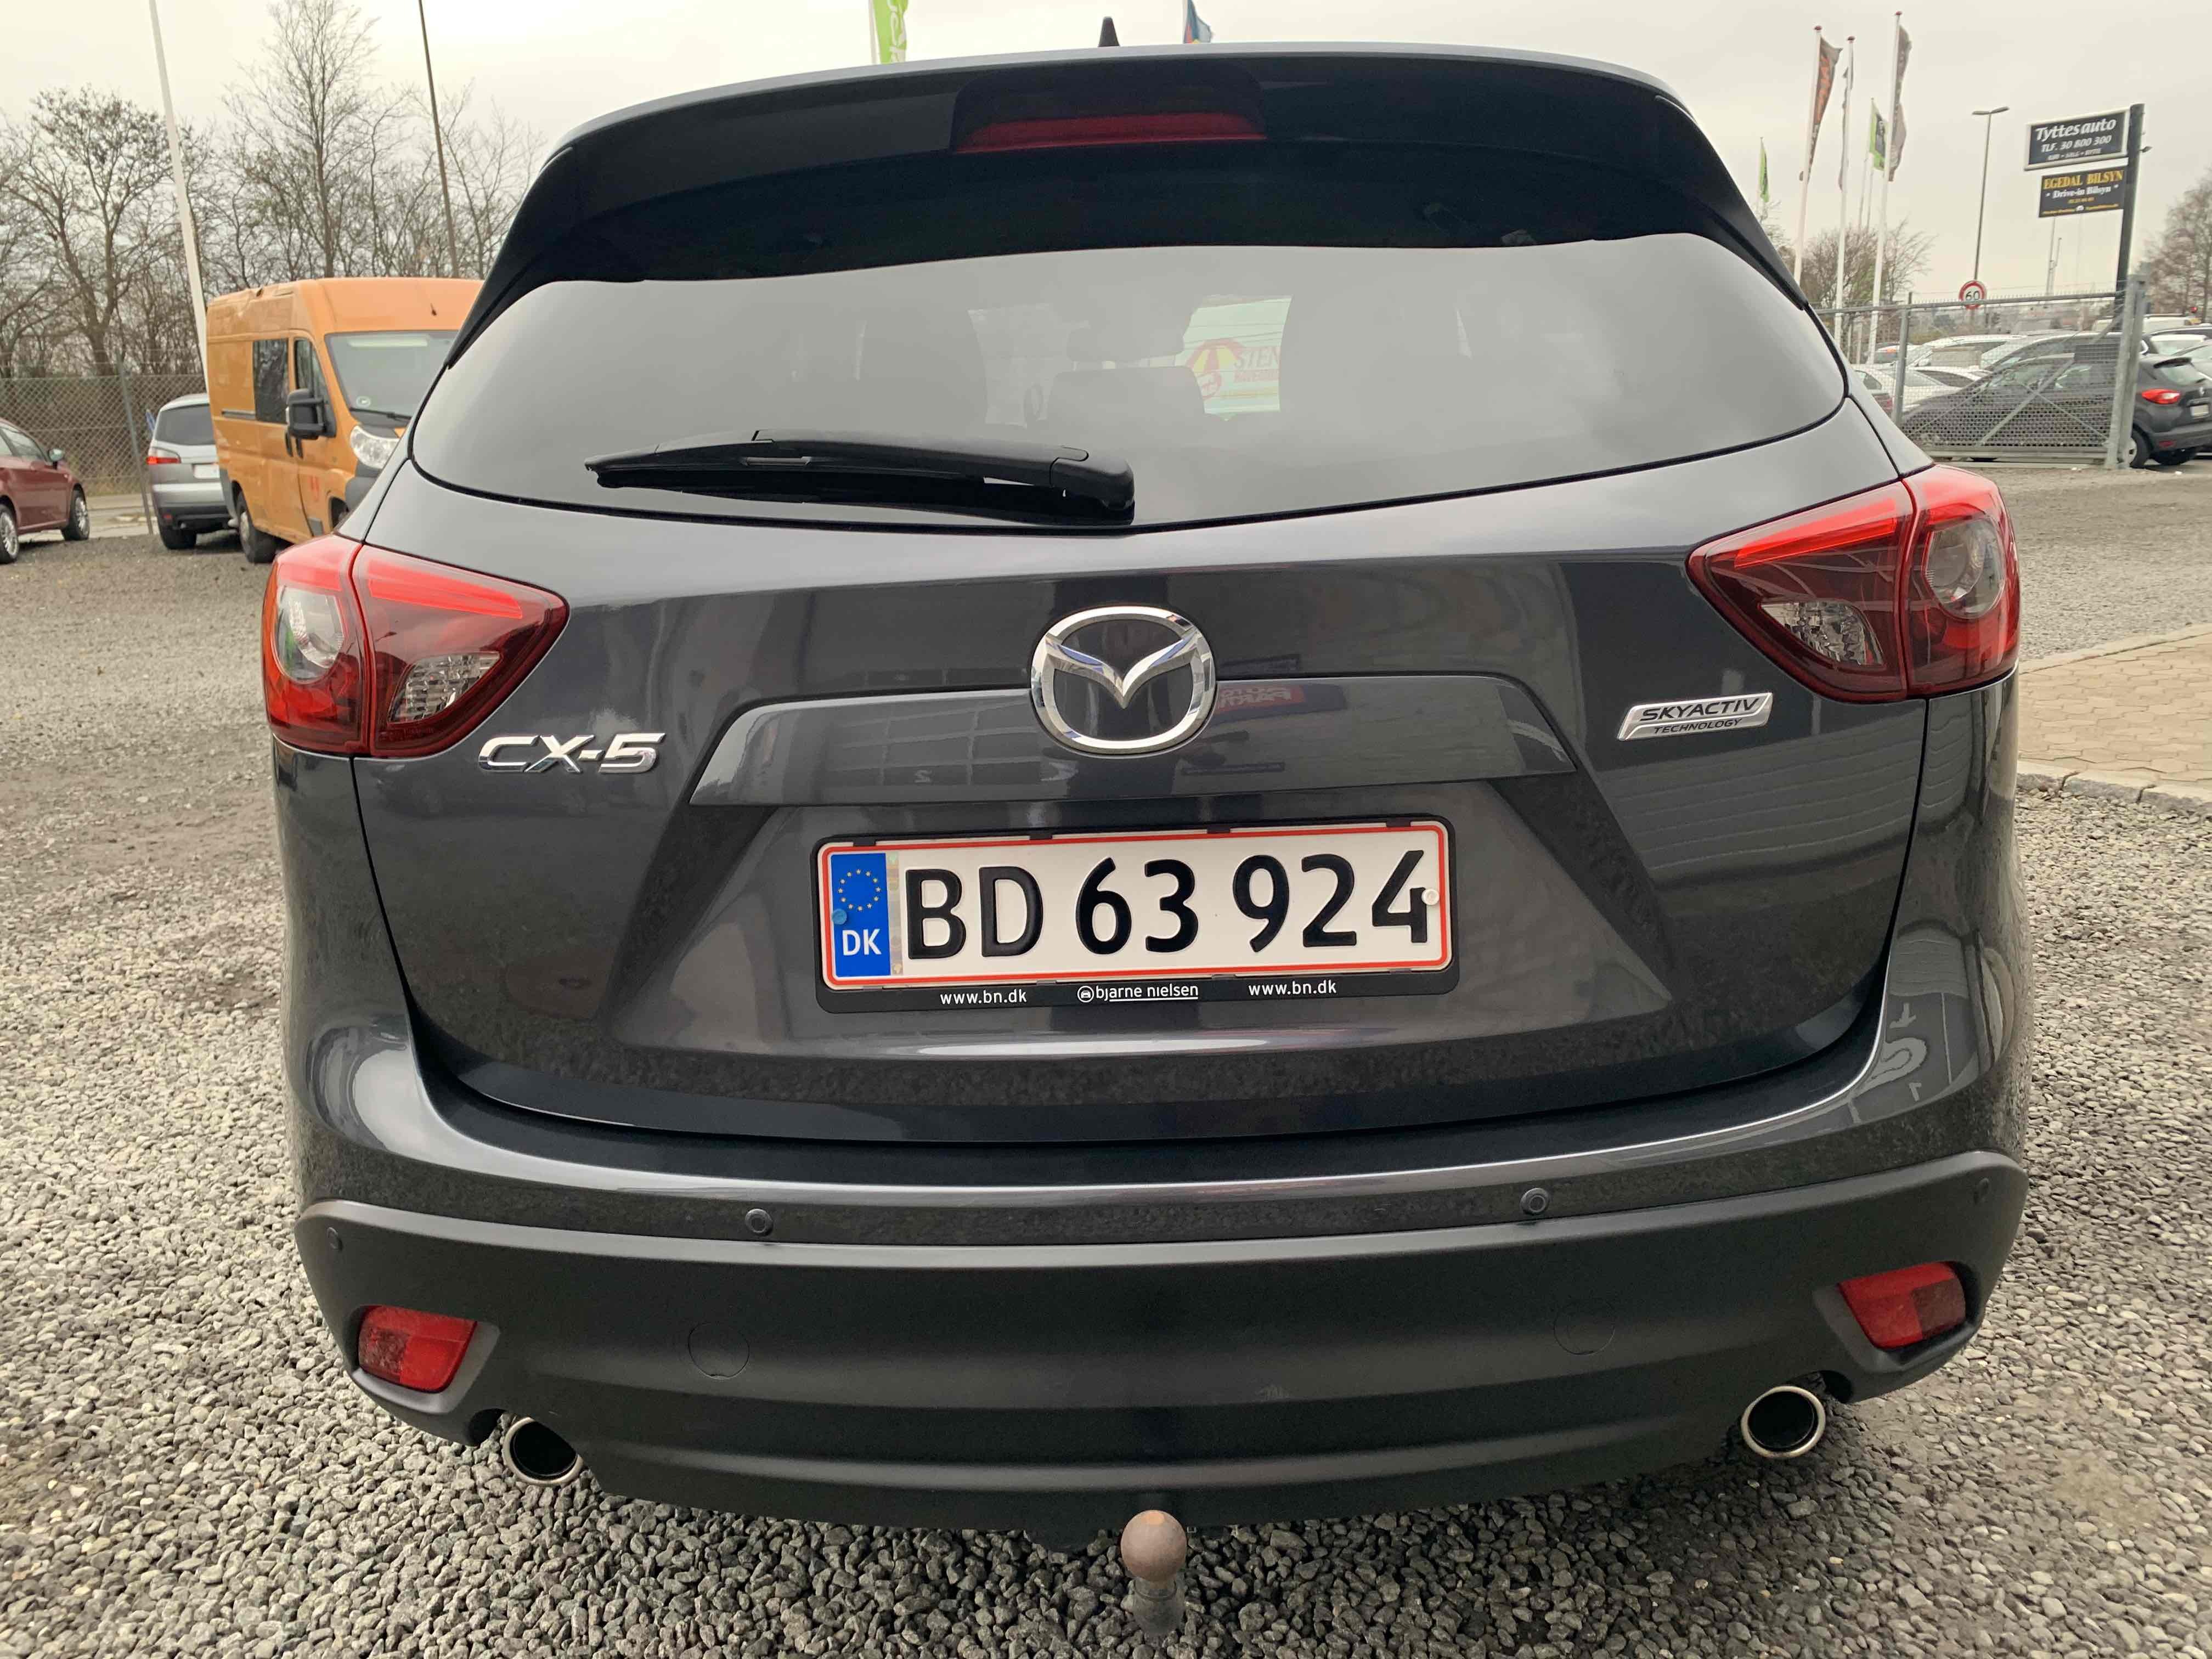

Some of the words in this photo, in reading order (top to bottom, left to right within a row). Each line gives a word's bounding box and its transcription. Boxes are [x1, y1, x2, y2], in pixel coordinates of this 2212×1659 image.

[2060, 140, 2073, 150] 30
[2094, 135, 2112, 145] 300
[2044, 175, 2083, 189] EGEDAL
[2087, 170, 2124, 184] BILSYN
[1966, 290, 1980, 301] 60
[1640, 698, 1759, 721] SKYACTIV
[1654, 719, 1742, 733] TECHNOLOGY
[478, 732, 665, 773] CX-5
[905, 866, 1043, 960] BD
[1075, 857, 1199, 955] 63
[1232, 850, 1428, 952] 924
[842, 928, 882, 956] DK
[940, 989, 1027, 1005] www.bn.dk
[1096, 985, 1142, 1001] bjarne
[1147, 983, 1199, 997] nielsen
[1248, 981, 1337, 996] www.bn.dk
